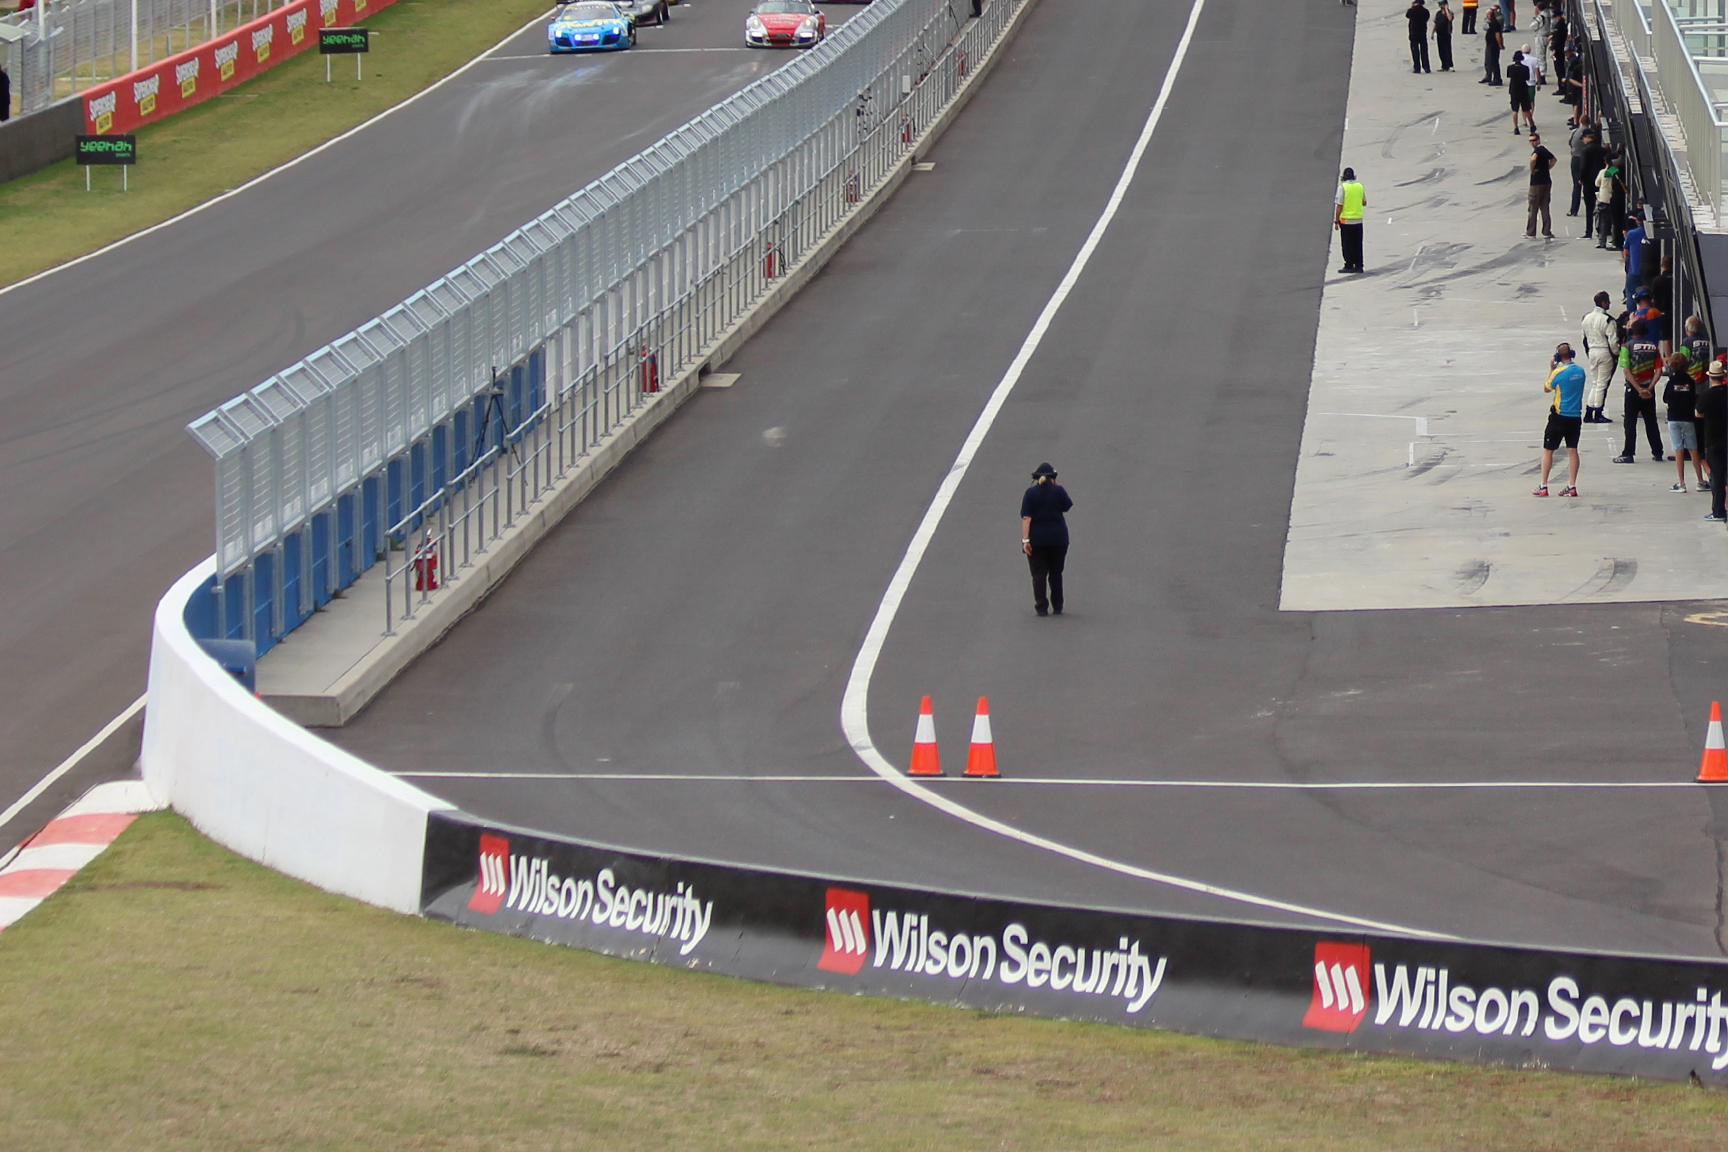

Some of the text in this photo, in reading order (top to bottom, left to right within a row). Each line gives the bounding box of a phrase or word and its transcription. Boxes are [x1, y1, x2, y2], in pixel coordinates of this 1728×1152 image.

[506, 854, 713, 956] Wilson Security
[872, 910, 1167, 1014] Wilson Security
[1374, 963, 1539, 1037] Wilson
